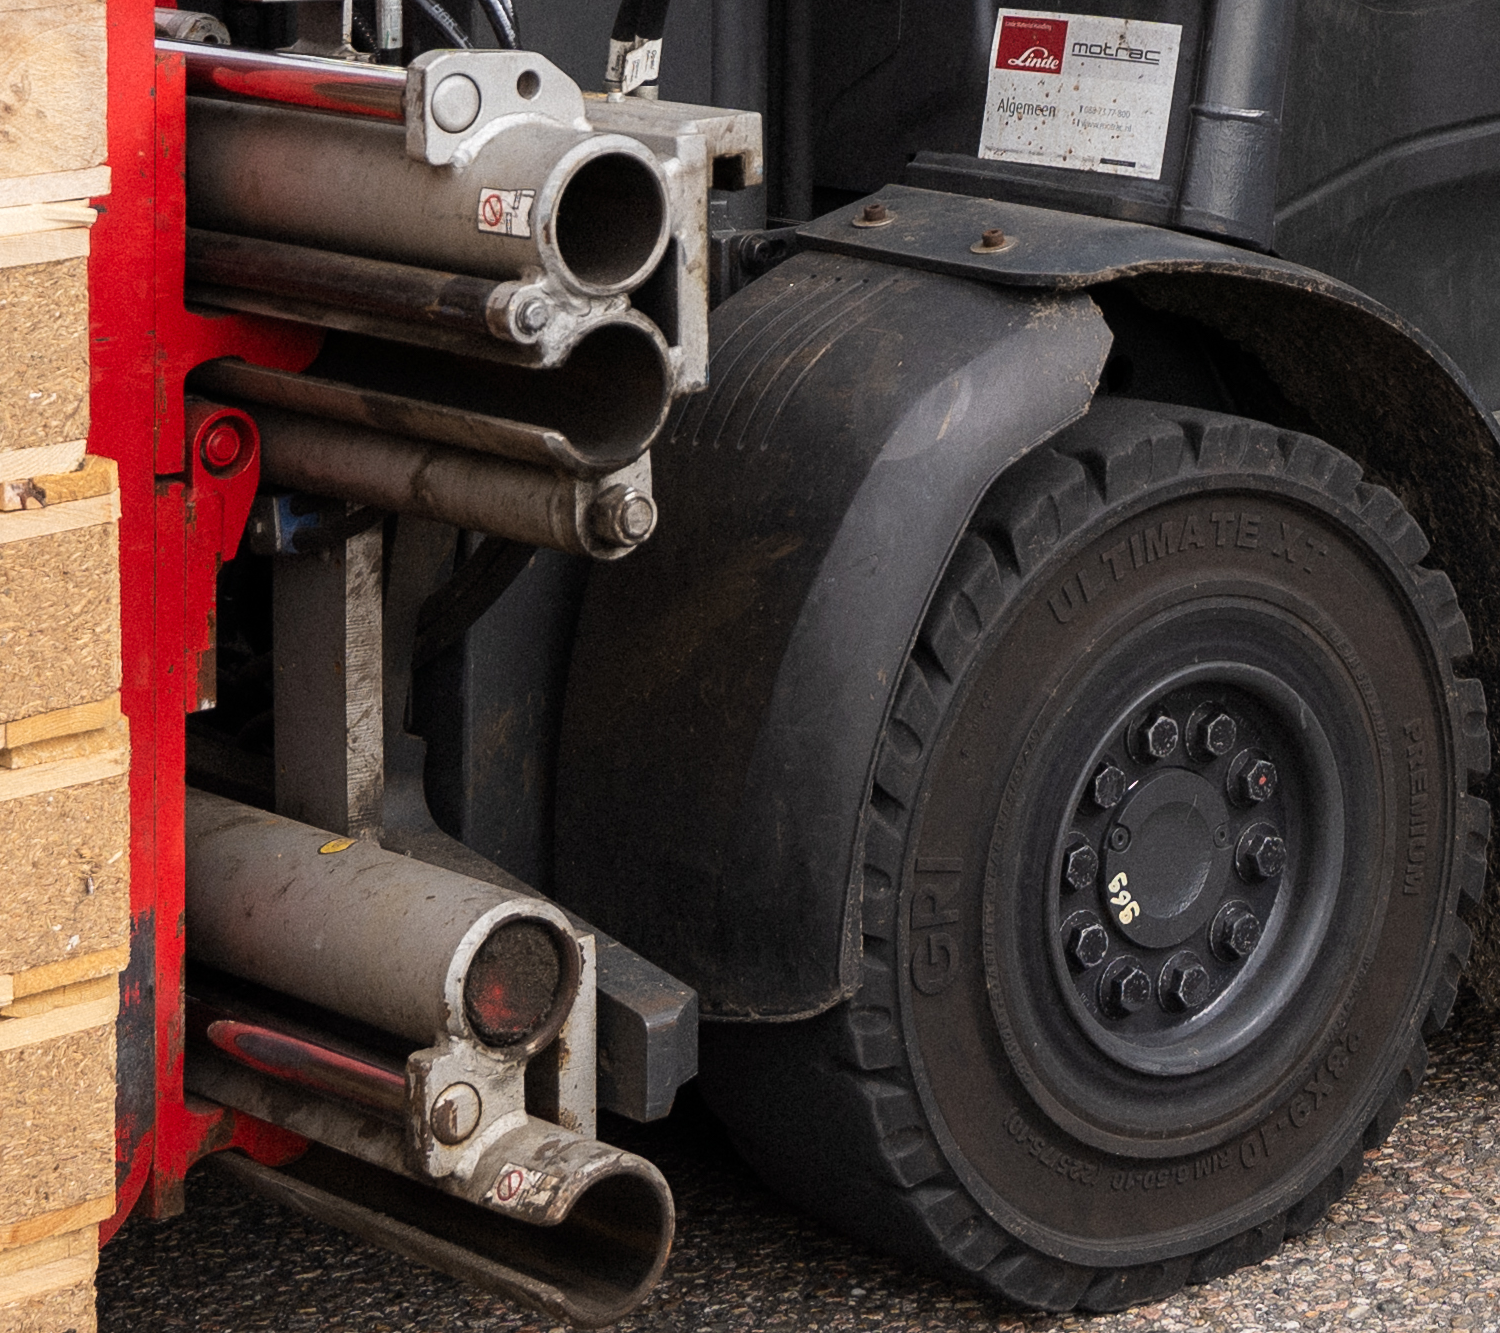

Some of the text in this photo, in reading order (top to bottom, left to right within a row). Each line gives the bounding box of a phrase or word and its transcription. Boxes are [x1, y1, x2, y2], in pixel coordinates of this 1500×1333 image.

[1007, 46, 1060, 71] Linde
[1071, 41, 1162, 63] motrac
[997, 96, 1057, 118] Algemeen
[1046, 511, 1329, 624] ULTIMATE XT
[1401, 717, 1429, 896] PREMIUM
[1109, 1162, 1193, 1193] 6.50-10
[1195, 1152, 1238, 1181] RIM
